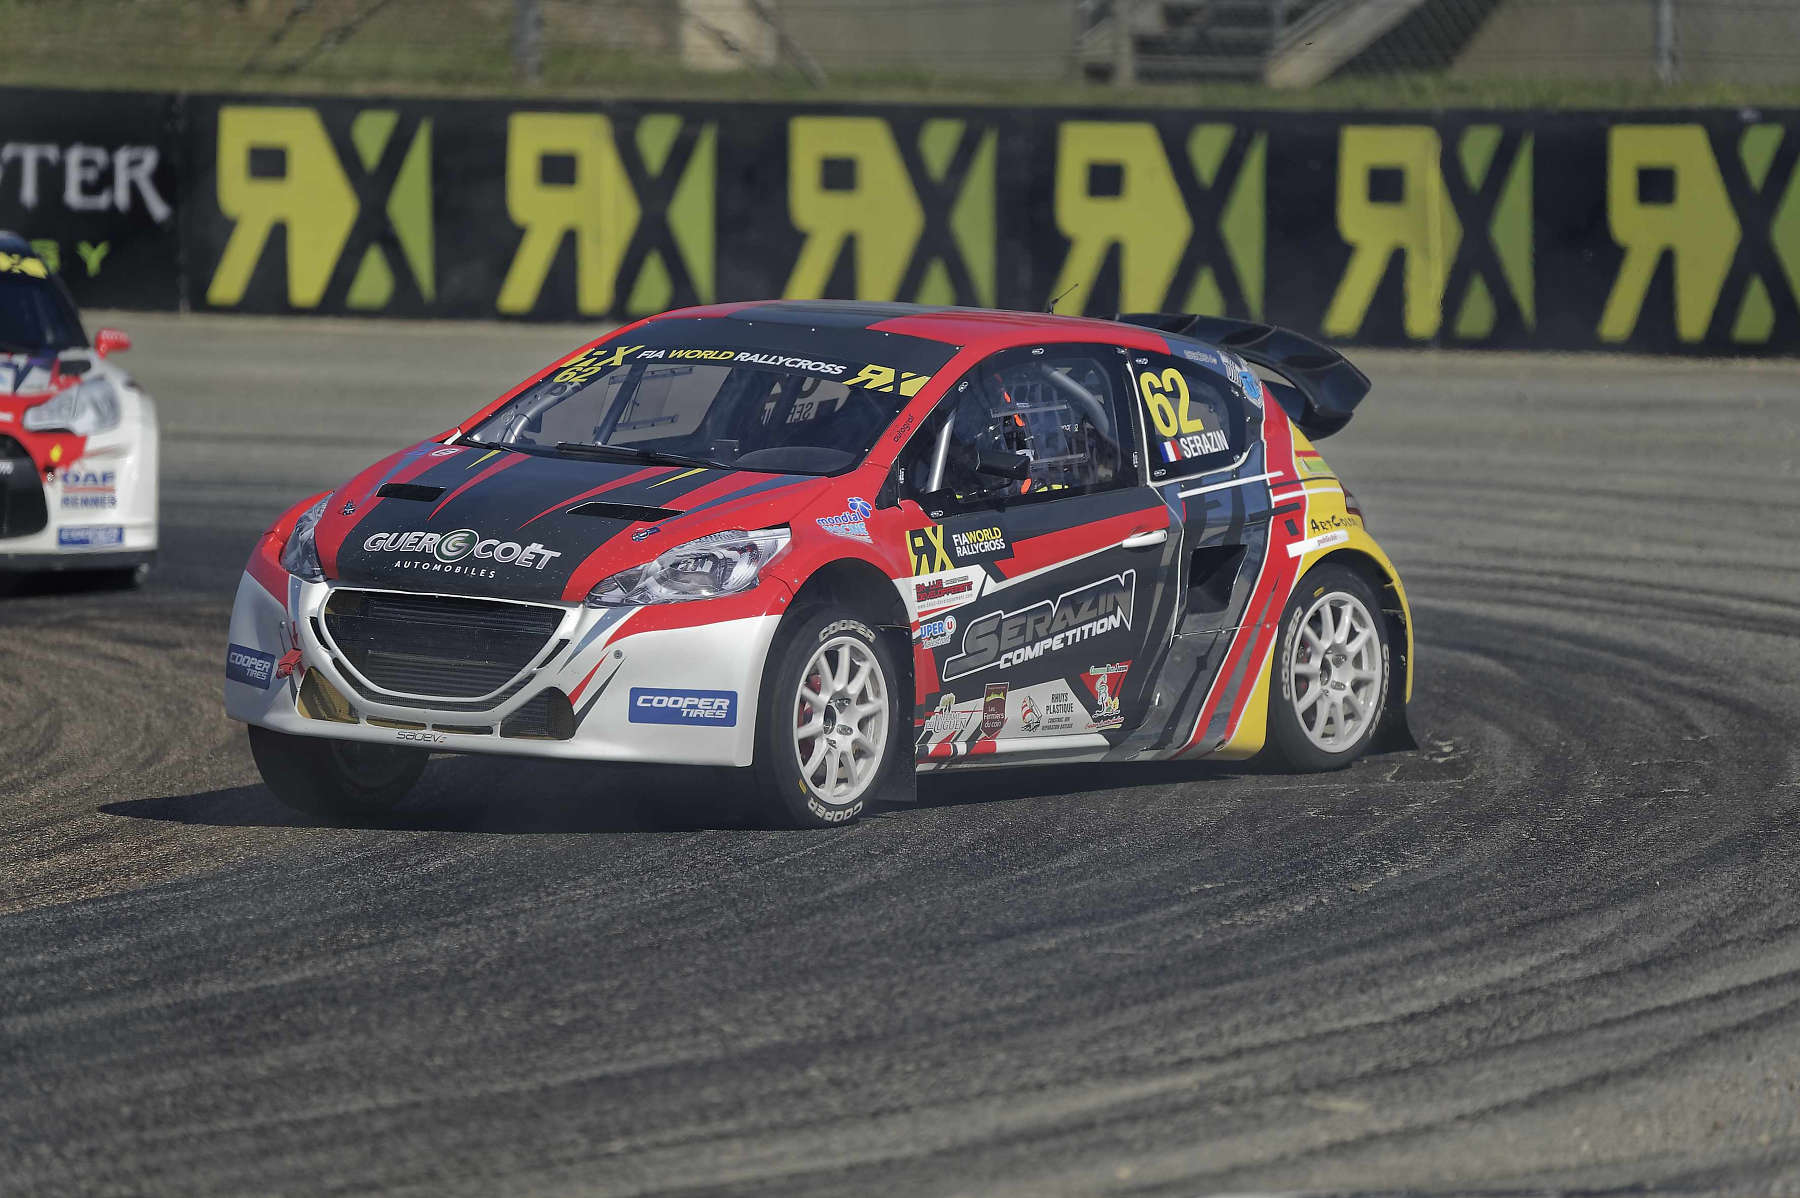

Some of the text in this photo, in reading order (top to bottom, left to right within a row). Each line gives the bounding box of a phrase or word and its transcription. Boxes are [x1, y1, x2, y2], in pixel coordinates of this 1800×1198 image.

[0, 142, 172, 223] TER
[206, 107, 435, 308] RX
[497, 112, 717, 314] RX
[1321, 125, 1536, 338] RX
[553, 366, 601, 383] 62
[636, 349, 849, 376] FIA WORLD RALLYCROSS
[1140, 367, 1204, 438] 62
[1180, 429, 1229, 459] SERAZIN
[816, 511, 864, 526] mondial
[955, 538, 1006, 557] RALLYCROSS
[394, 560, 497, 579] AUTOMOBILES
[920, 620, 945, 639] UPER
[942, 569, 1137, 682] SERAZIN
[1000, 613, 1121, 670] COMPETITION
[228, 651, 271, 673] COOPER
[246, 667, 269, 681] TIRES
[636, 695, 730, 710] COOPER
[680, 708, 728, 719] TIRES
[1045, 702, 1074, 715] PLASTIQUE
[807, 797, 864, 823] COOPER
